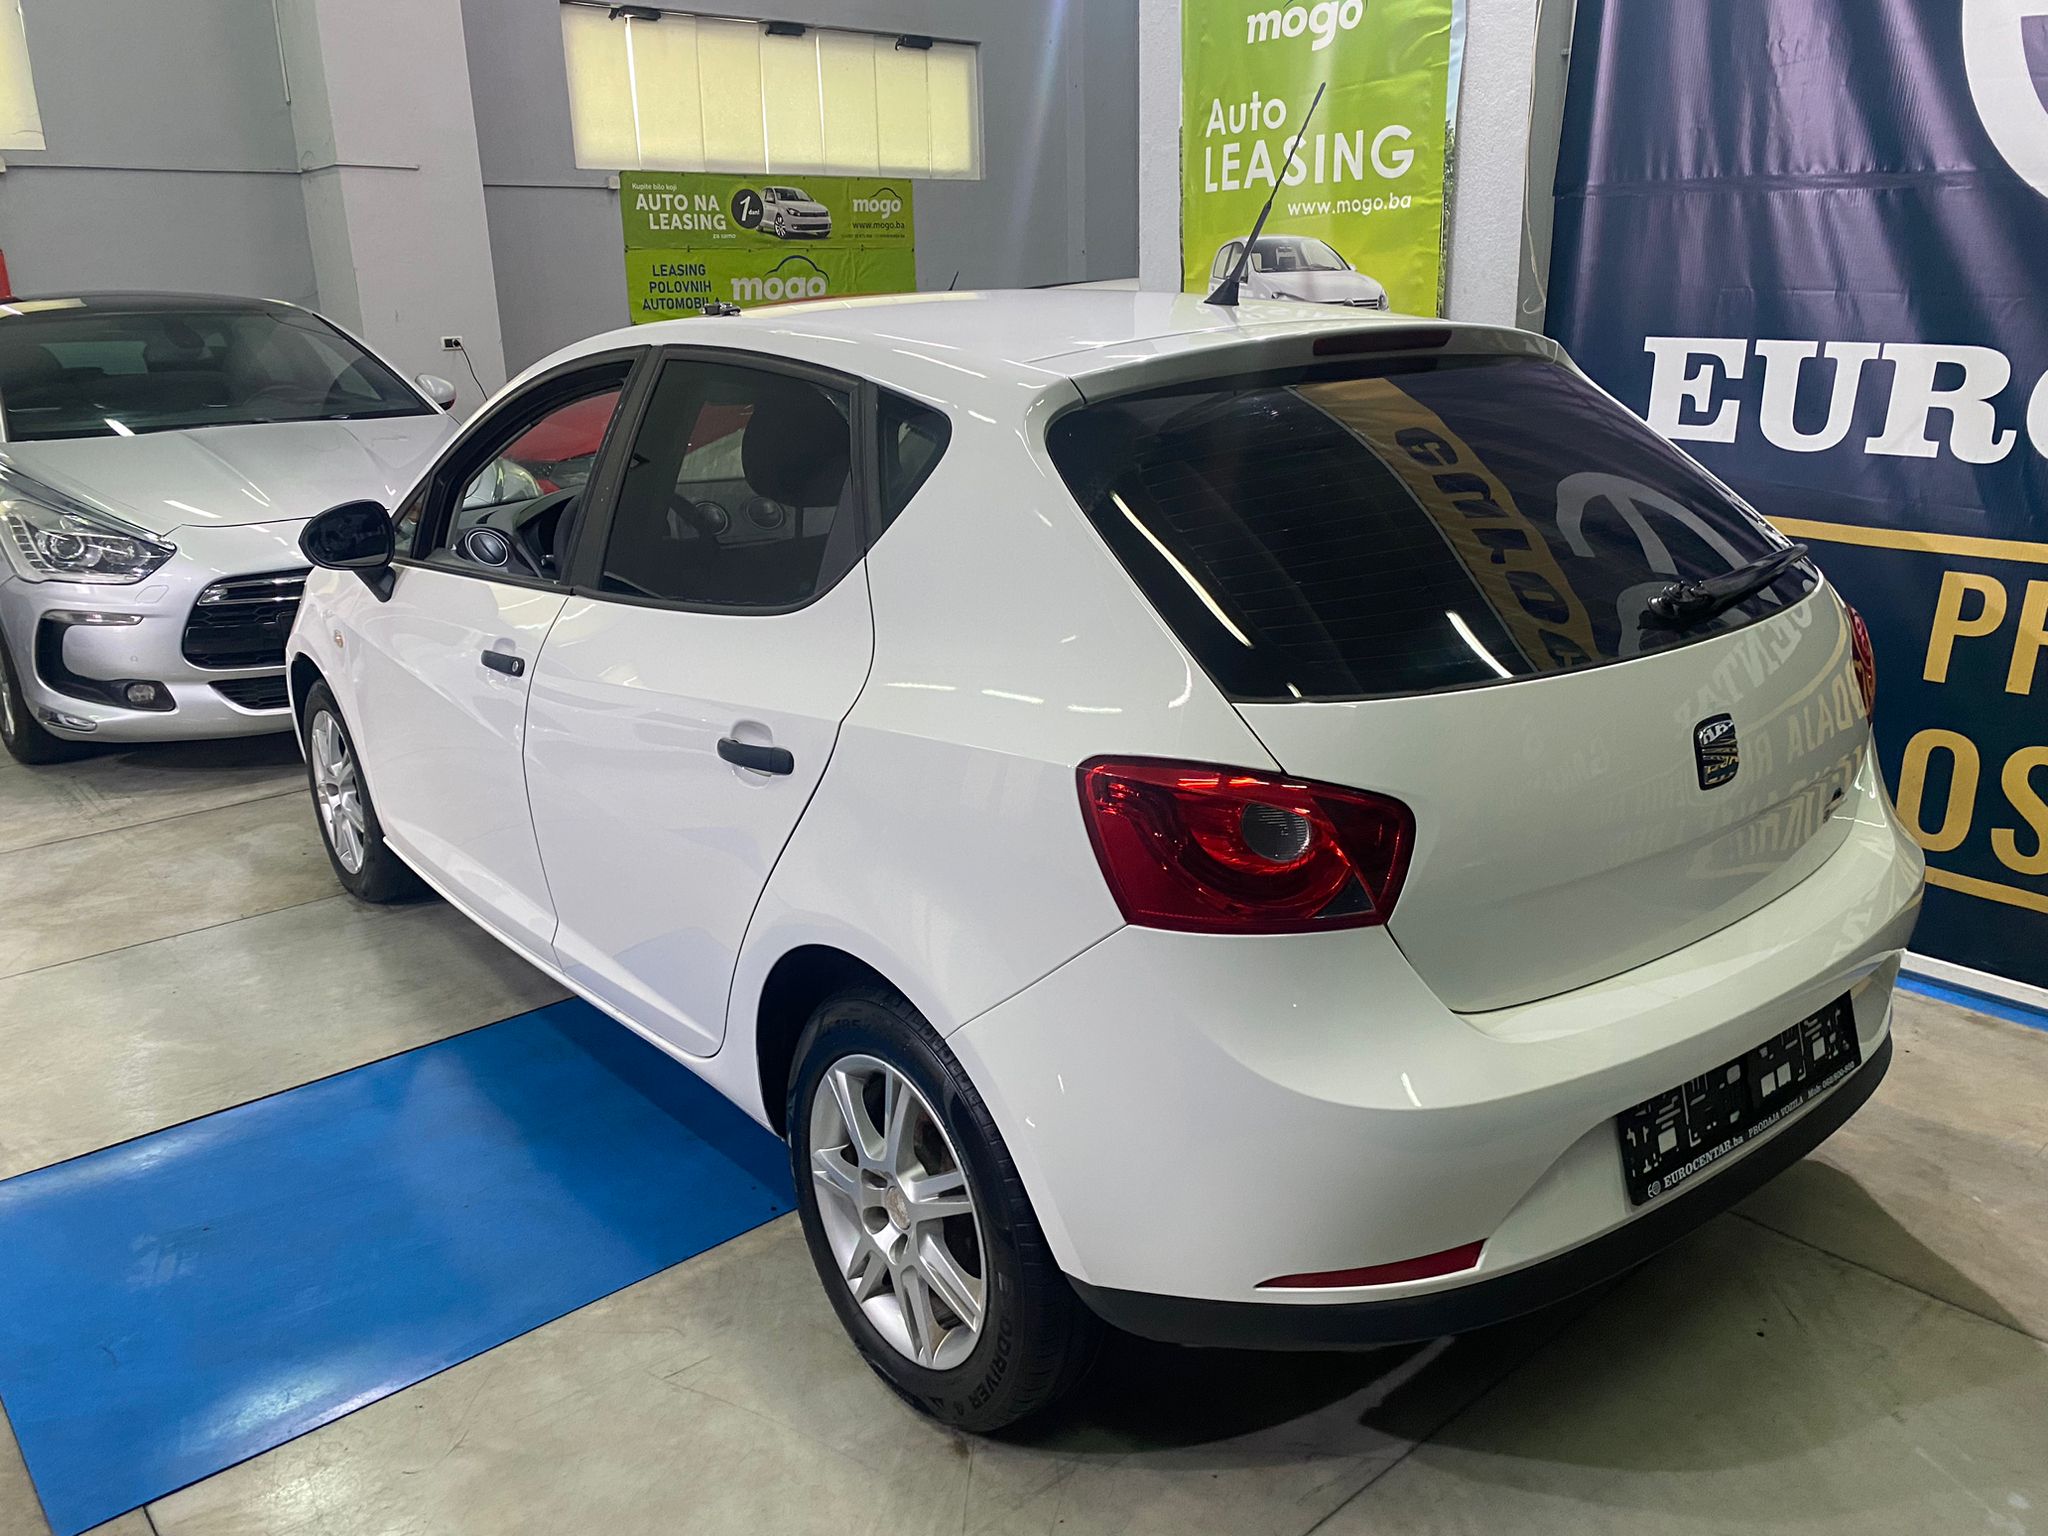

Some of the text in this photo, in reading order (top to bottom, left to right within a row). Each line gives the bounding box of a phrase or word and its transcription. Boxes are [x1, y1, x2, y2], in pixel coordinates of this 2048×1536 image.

[1247, 0, 1364, 51] mogo
[1205, 91, 1287, 138] Auto
[1205, 124, 1414, 193] LEASING
[632, 182, 652, 191] Kupite
[636, 193, 720, 211] AUTO NA
[740, 195, 751, 222] 1
[853, 199, 901, 219] mogo
[1288, 193, 1412, 215] www.mogo.ba
[649, 213, 726, 230] LEASING
[852, 221, 905, 230] www.mogo.ba
[653, 264, 706, 278] LEASING
[649, 280, 711, 294] POLOVNIH
[1645, 337, 2048, 464] EUR
[1663, 1135, 1744, 1189] EUROCENTAR.ba
[1748, 1112, 1780, 1137] PRODAJA
[1780, 1095, 1804, 1118] VOZILA
